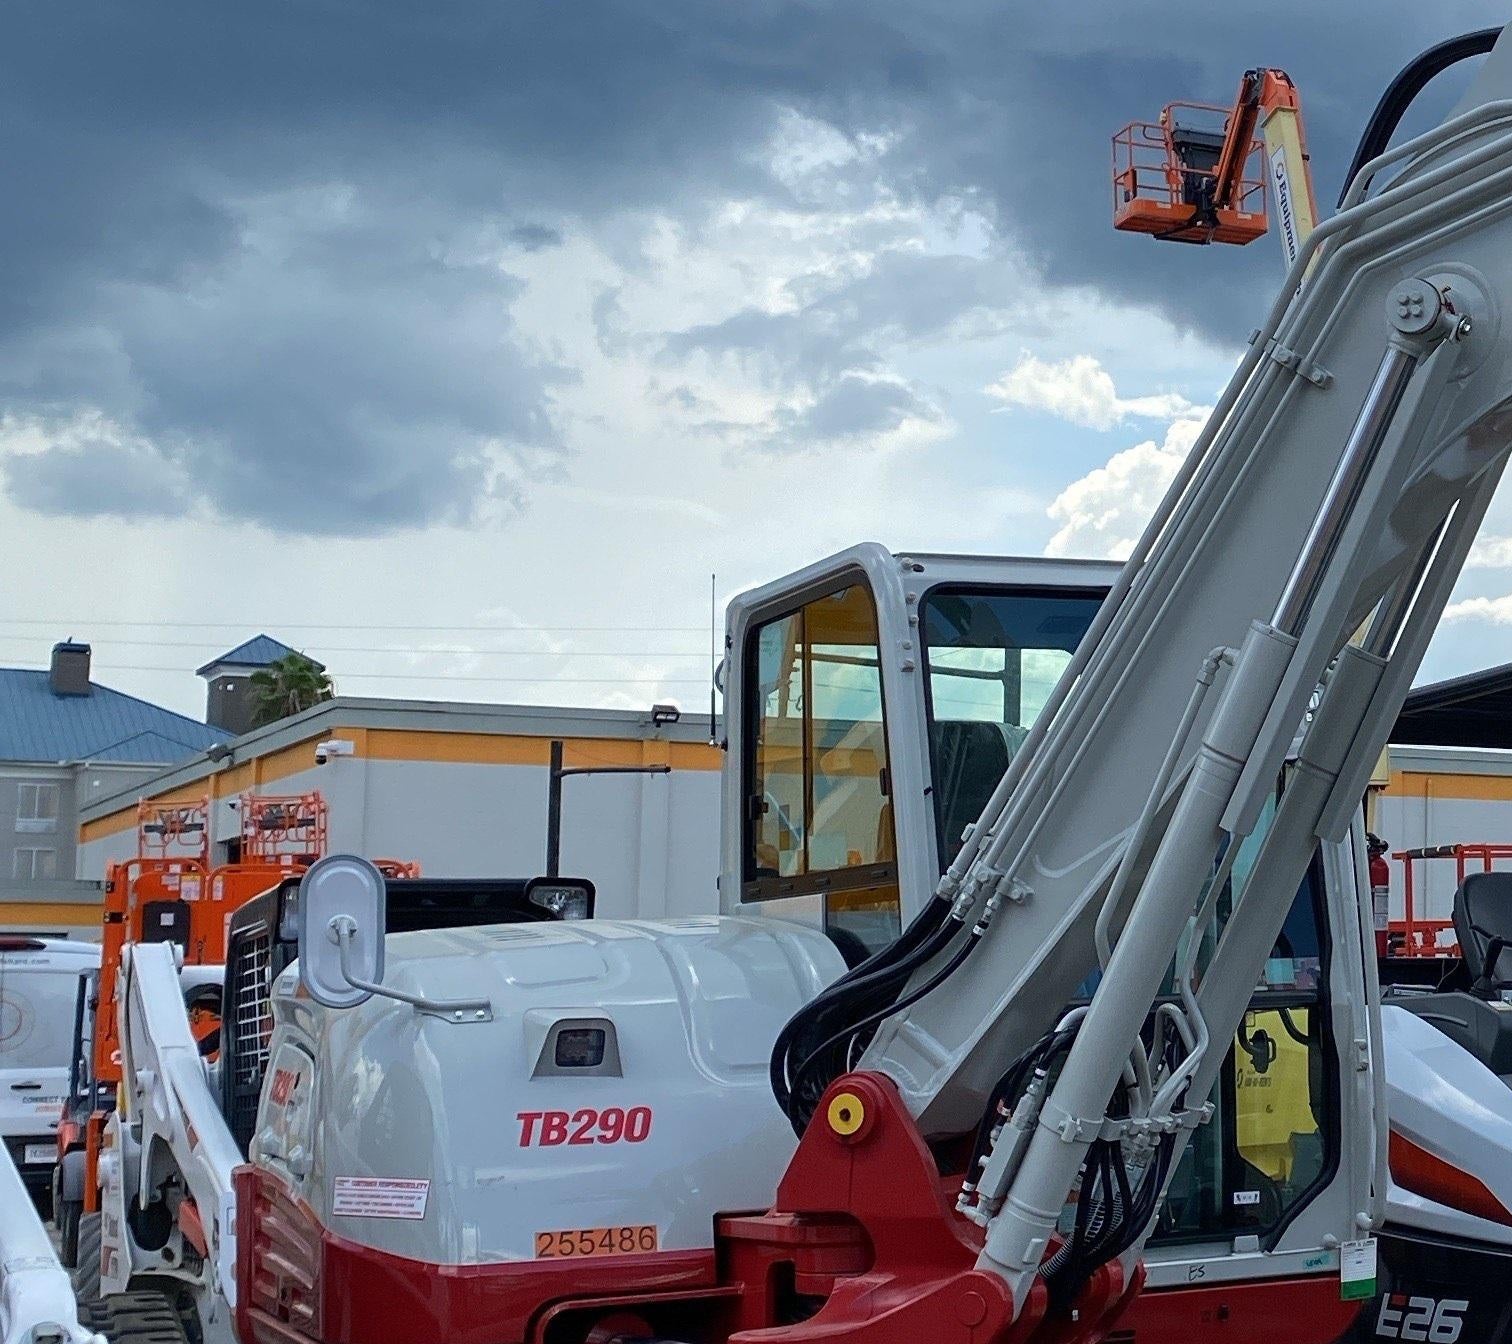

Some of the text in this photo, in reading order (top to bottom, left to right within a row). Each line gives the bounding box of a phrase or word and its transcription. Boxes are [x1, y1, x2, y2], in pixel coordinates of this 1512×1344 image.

[516, 1106, 652, 1147] TB290
[537, 1227, 655, 1256] 255486
[1375, 1292, 1470, 1344] E26
